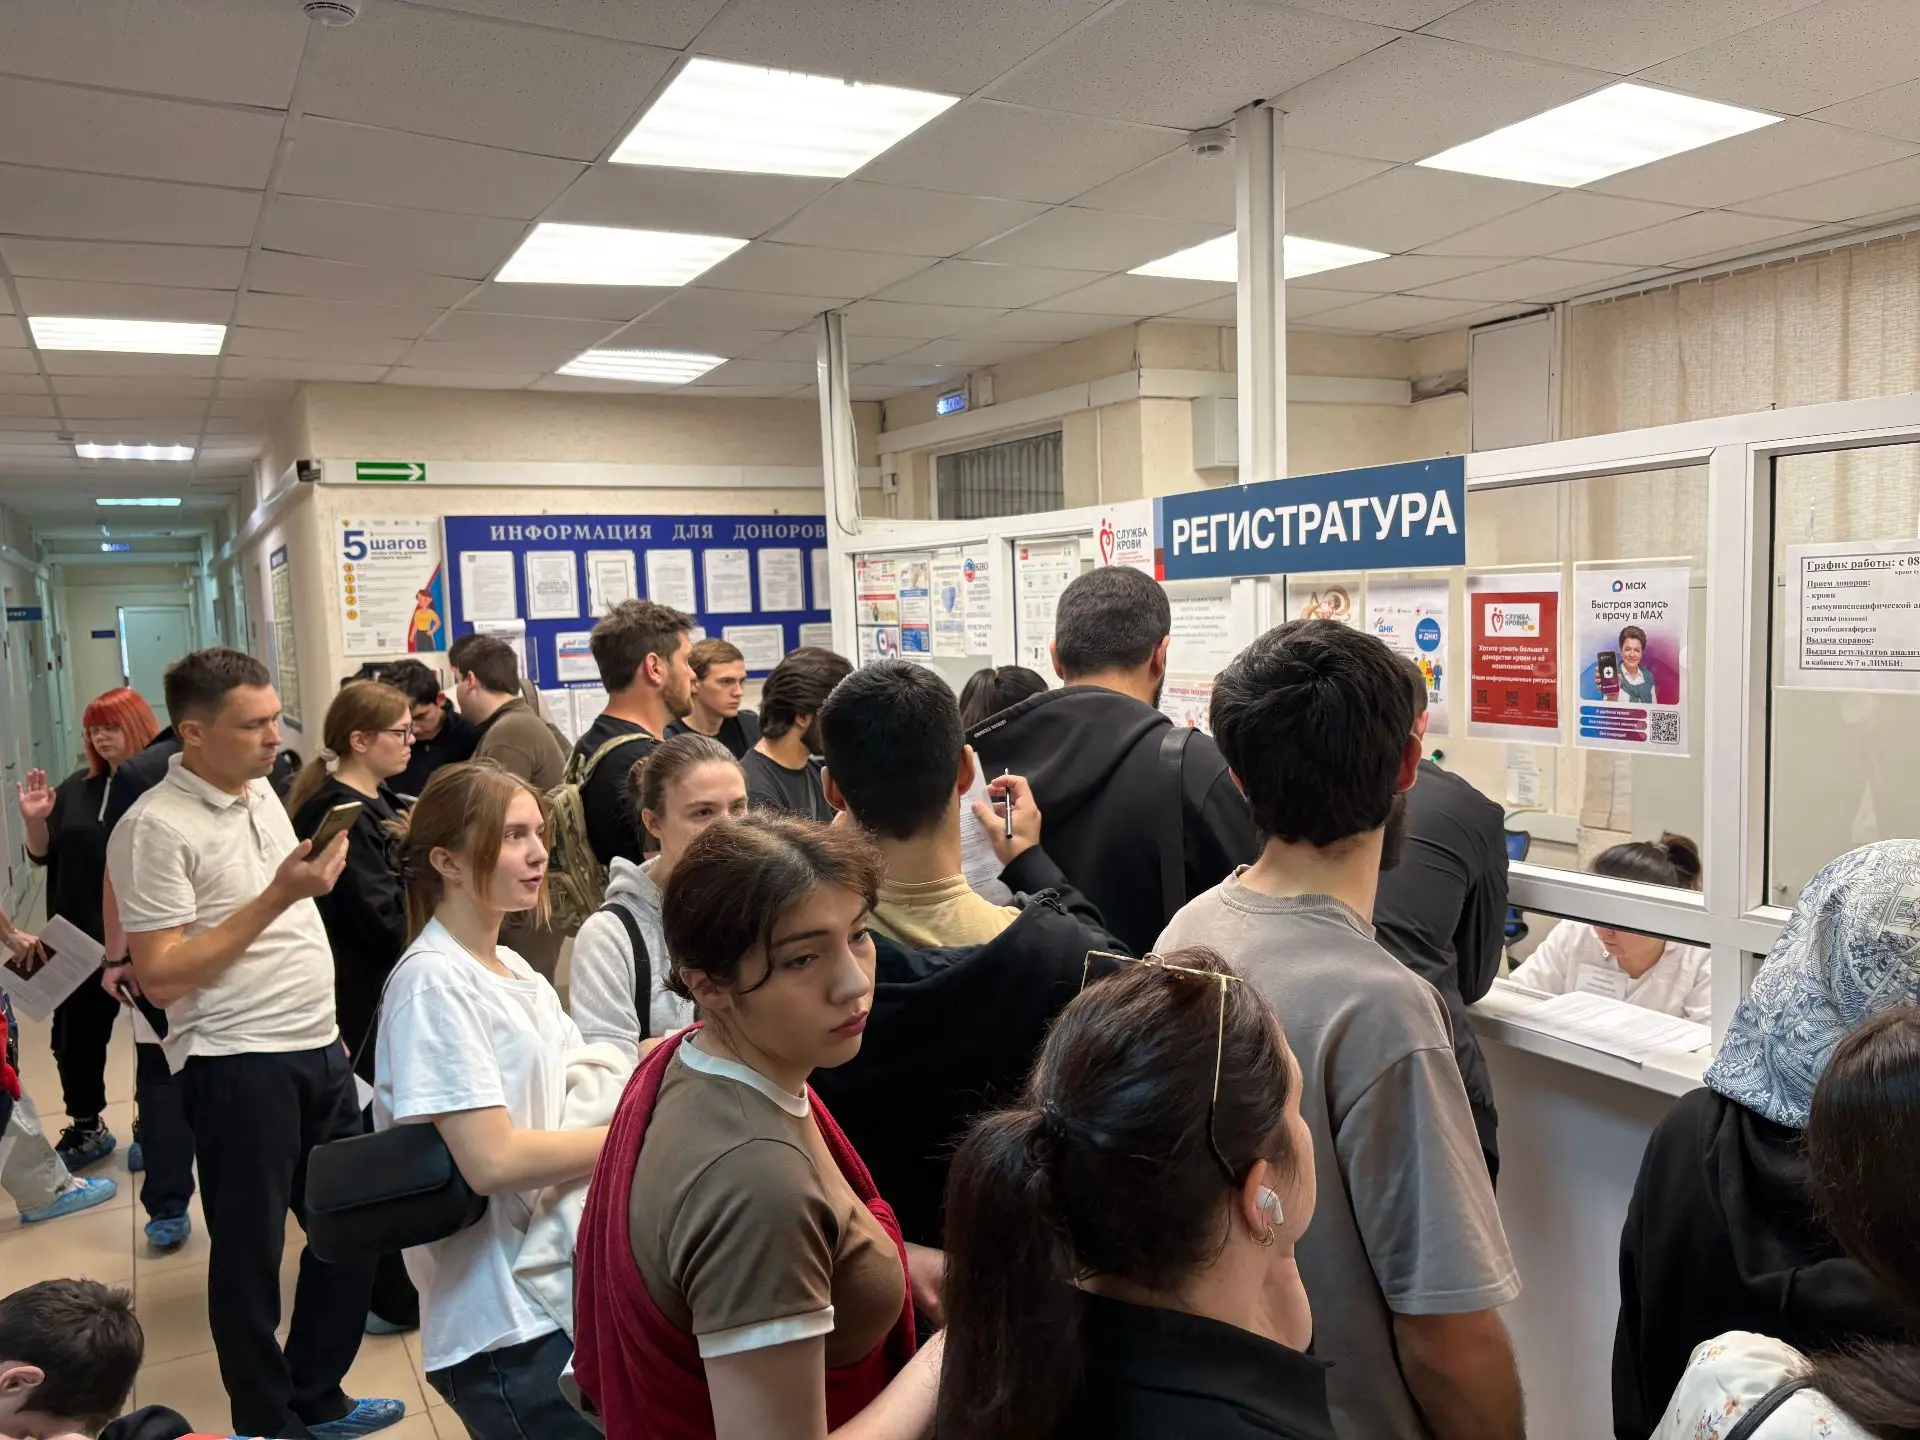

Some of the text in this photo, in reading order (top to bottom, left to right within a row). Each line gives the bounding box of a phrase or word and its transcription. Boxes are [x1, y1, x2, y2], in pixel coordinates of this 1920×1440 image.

[1173, 489, 1457, 556] РЕГИСТРАТУРА
[490, 524, 826, 542] ИНФОРМАЦИЯ ДЛЯ ДОНОРОВ
[1116, 528, 1148, 540] СЛУЖБА
[343, 530, 428, 561] 5 шагов
[1116, 539, 1141, 550] КРОВИ
[1807, 561, 1848, 571] График
[1851, 559, 1895, 570] работы:
[1898, 559, 1905, 567] с
[1807, 579, 1871, 588] Прием доноров:
[1591, 600, 1669, 611] Быстрая запись
[1505, 613, 1530, 621] СЛУЖБА
[1602, 612, 1630, 621] врачу
[1379, 625, 1393, 633] ДНК
[1806, 636, 1875, 645] Выдача справок:
[1498, 646, 1518, 654] узнать
[1512, 655, 1531, 663] крови
[1491, 663, 1534, 671] компонентов?
